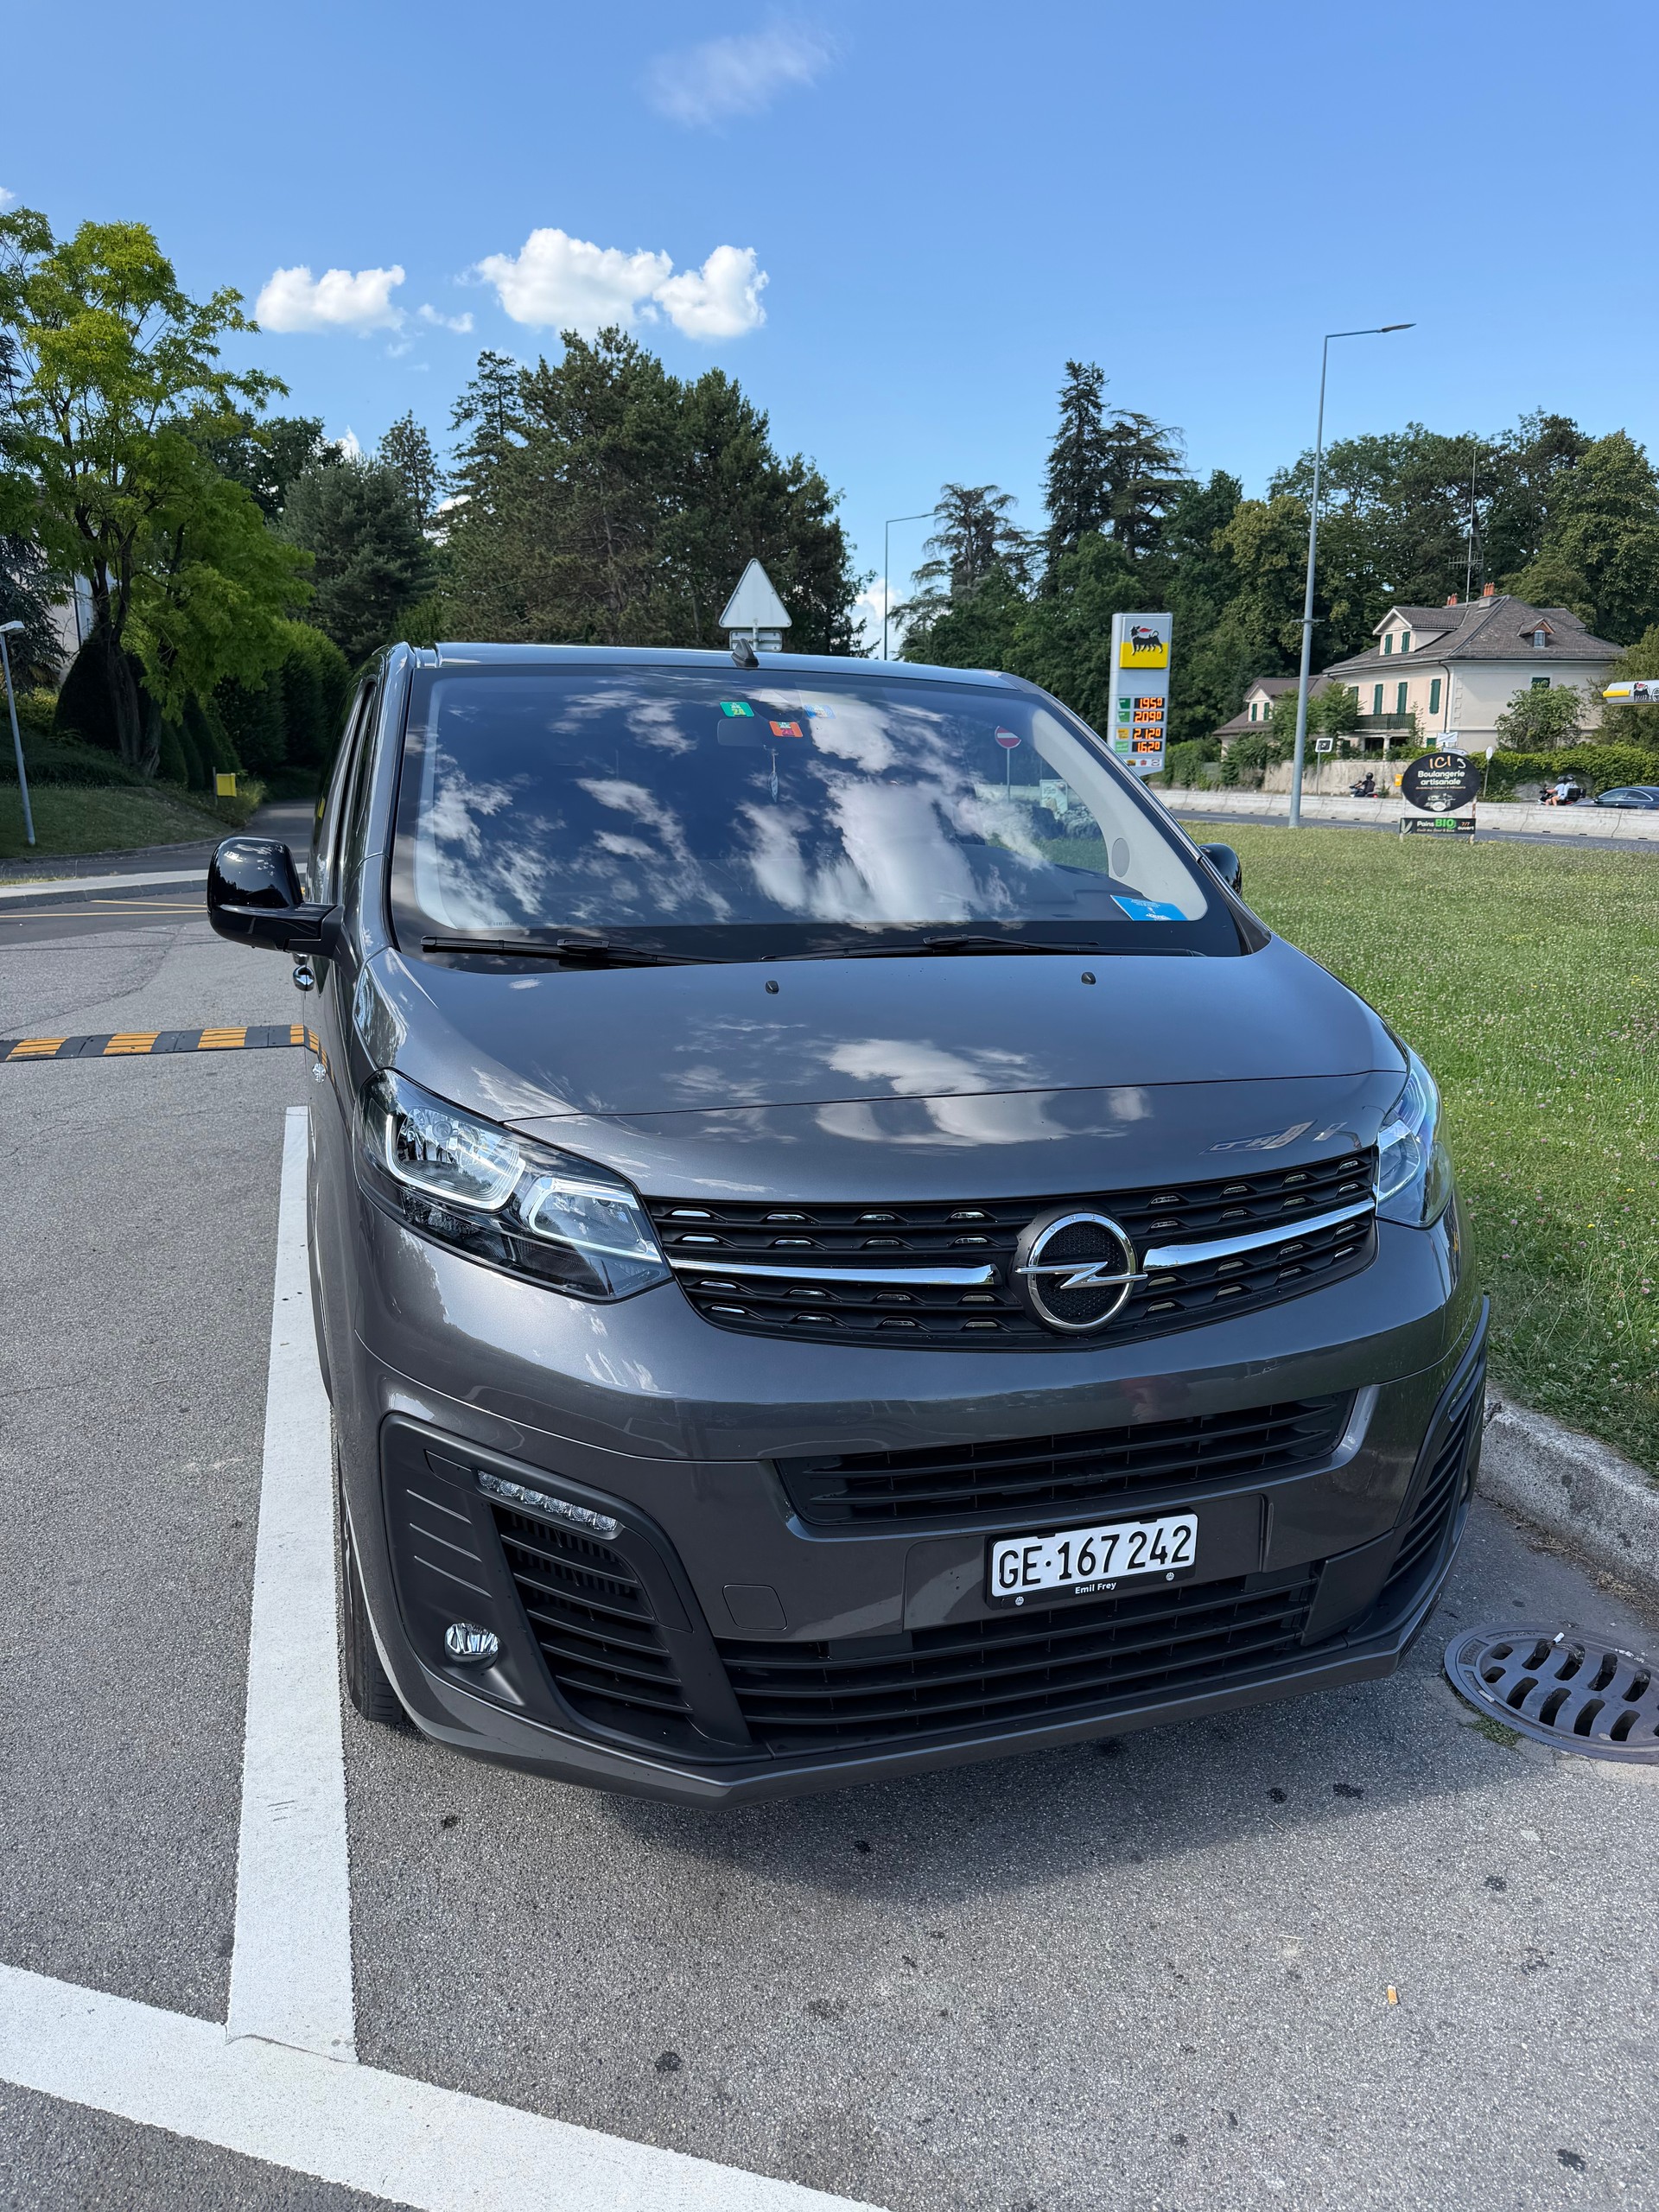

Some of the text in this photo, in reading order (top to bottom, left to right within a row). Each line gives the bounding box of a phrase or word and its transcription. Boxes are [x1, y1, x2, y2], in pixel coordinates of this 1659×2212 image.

[1429, 755, 1451, 769] ICI
[1418, 770, 1465, 779] Boulangerie
[1435, 818, 1454, 829] BIO
[1075, 1582, 1117, 1594] Emil Frey
